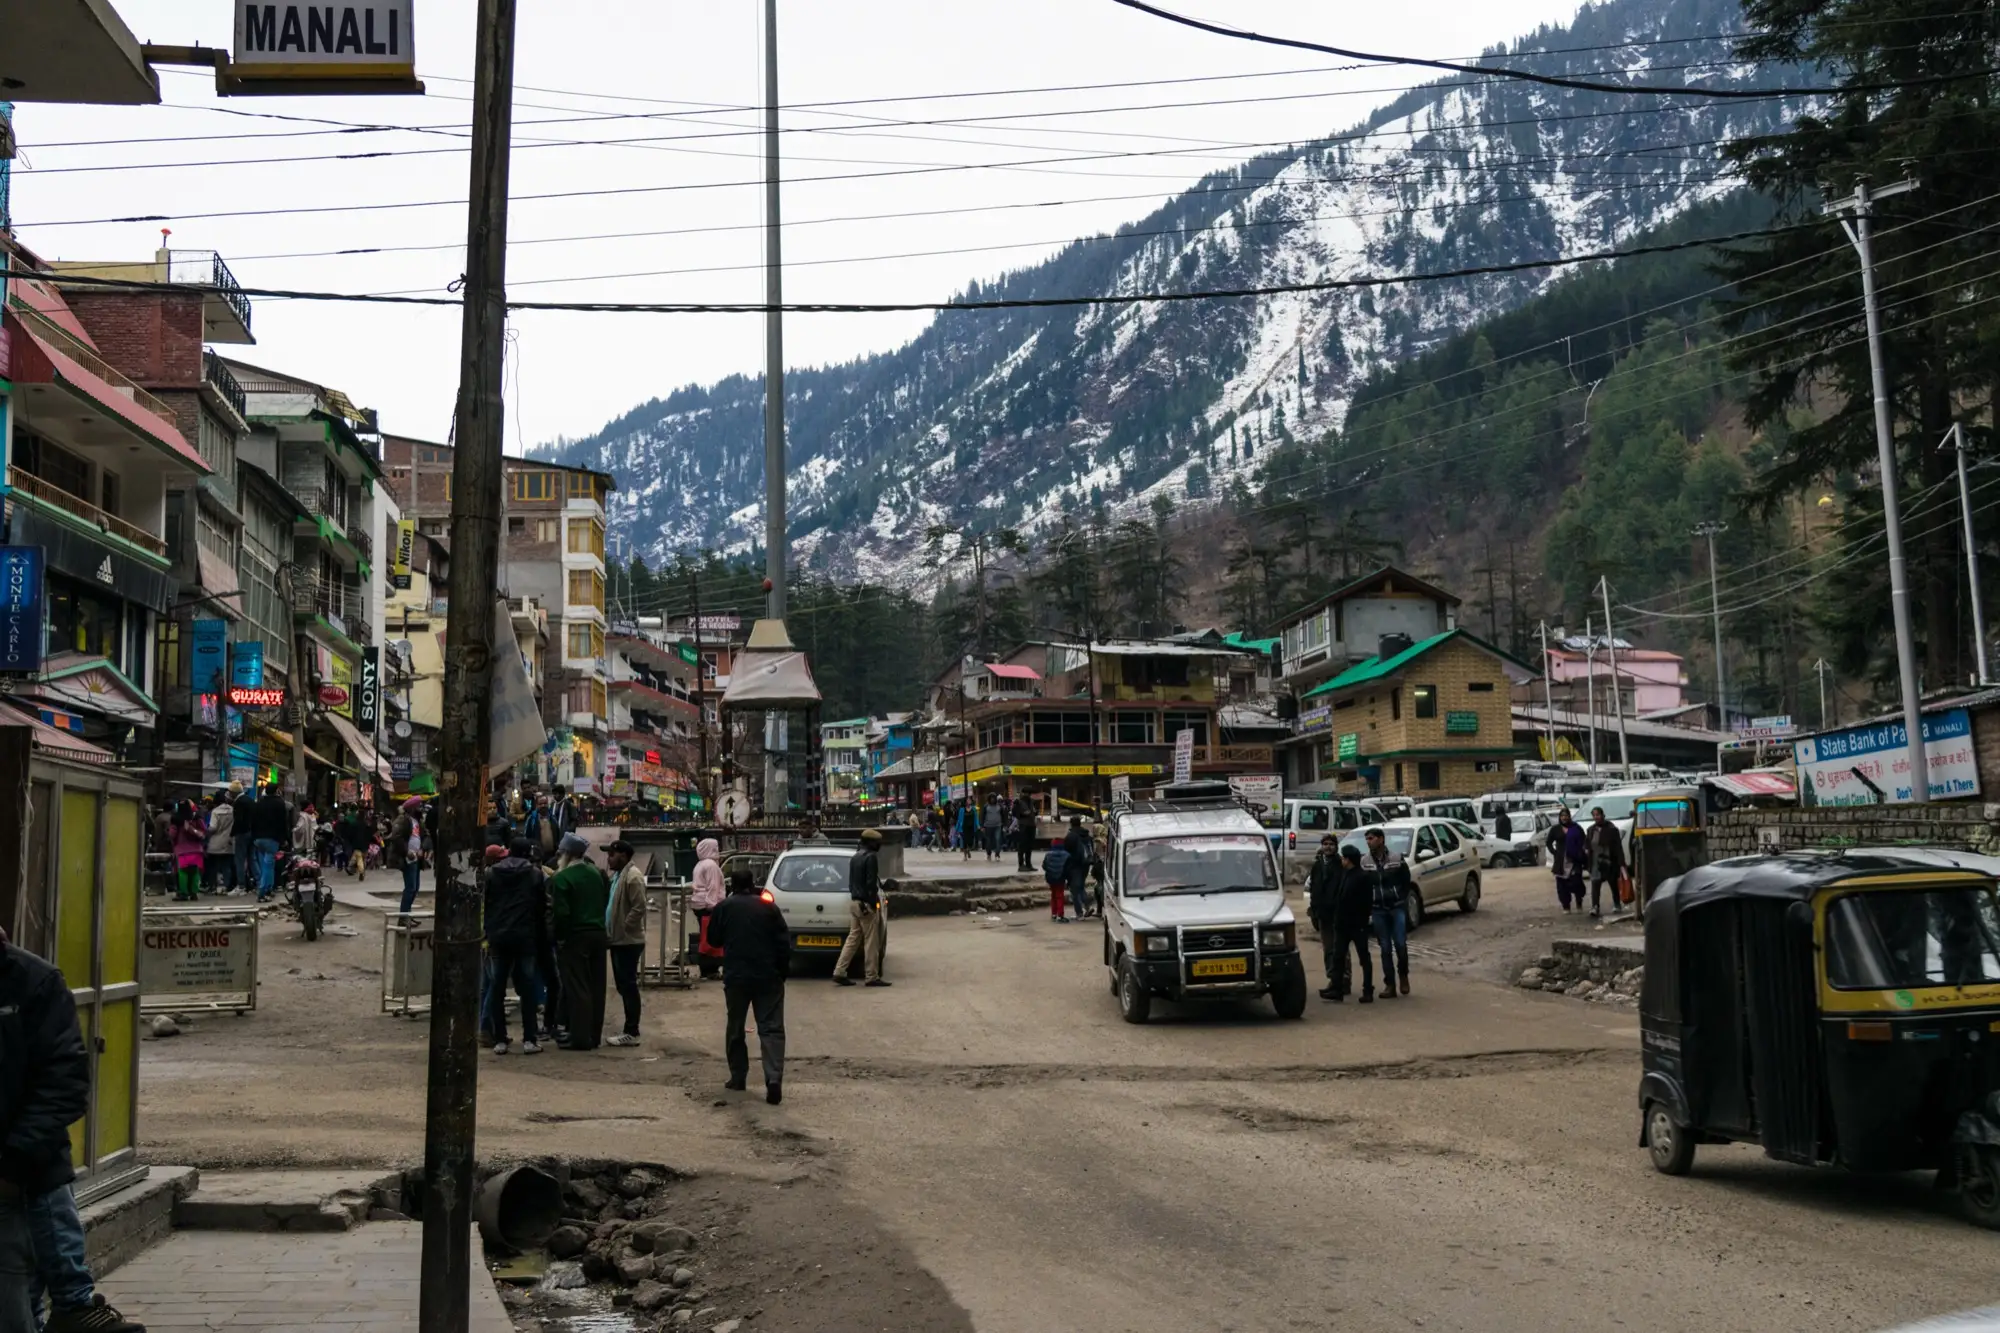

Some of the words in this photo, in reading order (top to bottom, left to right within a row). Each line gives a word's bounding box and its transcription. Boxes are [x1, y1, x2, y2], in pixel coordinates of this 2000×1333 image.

[245, 4, 398, 55] MANALI
[398, 529, 412, 566] Nikon
[96, 570, 114, 585] adidas
[10, 566, 23, 613] MONTE
[7, 615, 20, 663] CARLO
[322, 688, 344, 697] HOTEL
[361, 659, 376, 720] SONY
[1744, 728, 1773, 737] NEGI
[1934, 722, 1963, 736] MANALI
[1821, 737, 1847, 756] State
[1849, 729, 1875, 750] Bank
[1878, 728, 1890, 746] of
[1946, 780, 1952, 793] &
[1953, 778, 1974, 792] There
[144, 930, 230, 949] CHECKING
[187, 951, 197, 959] BY
